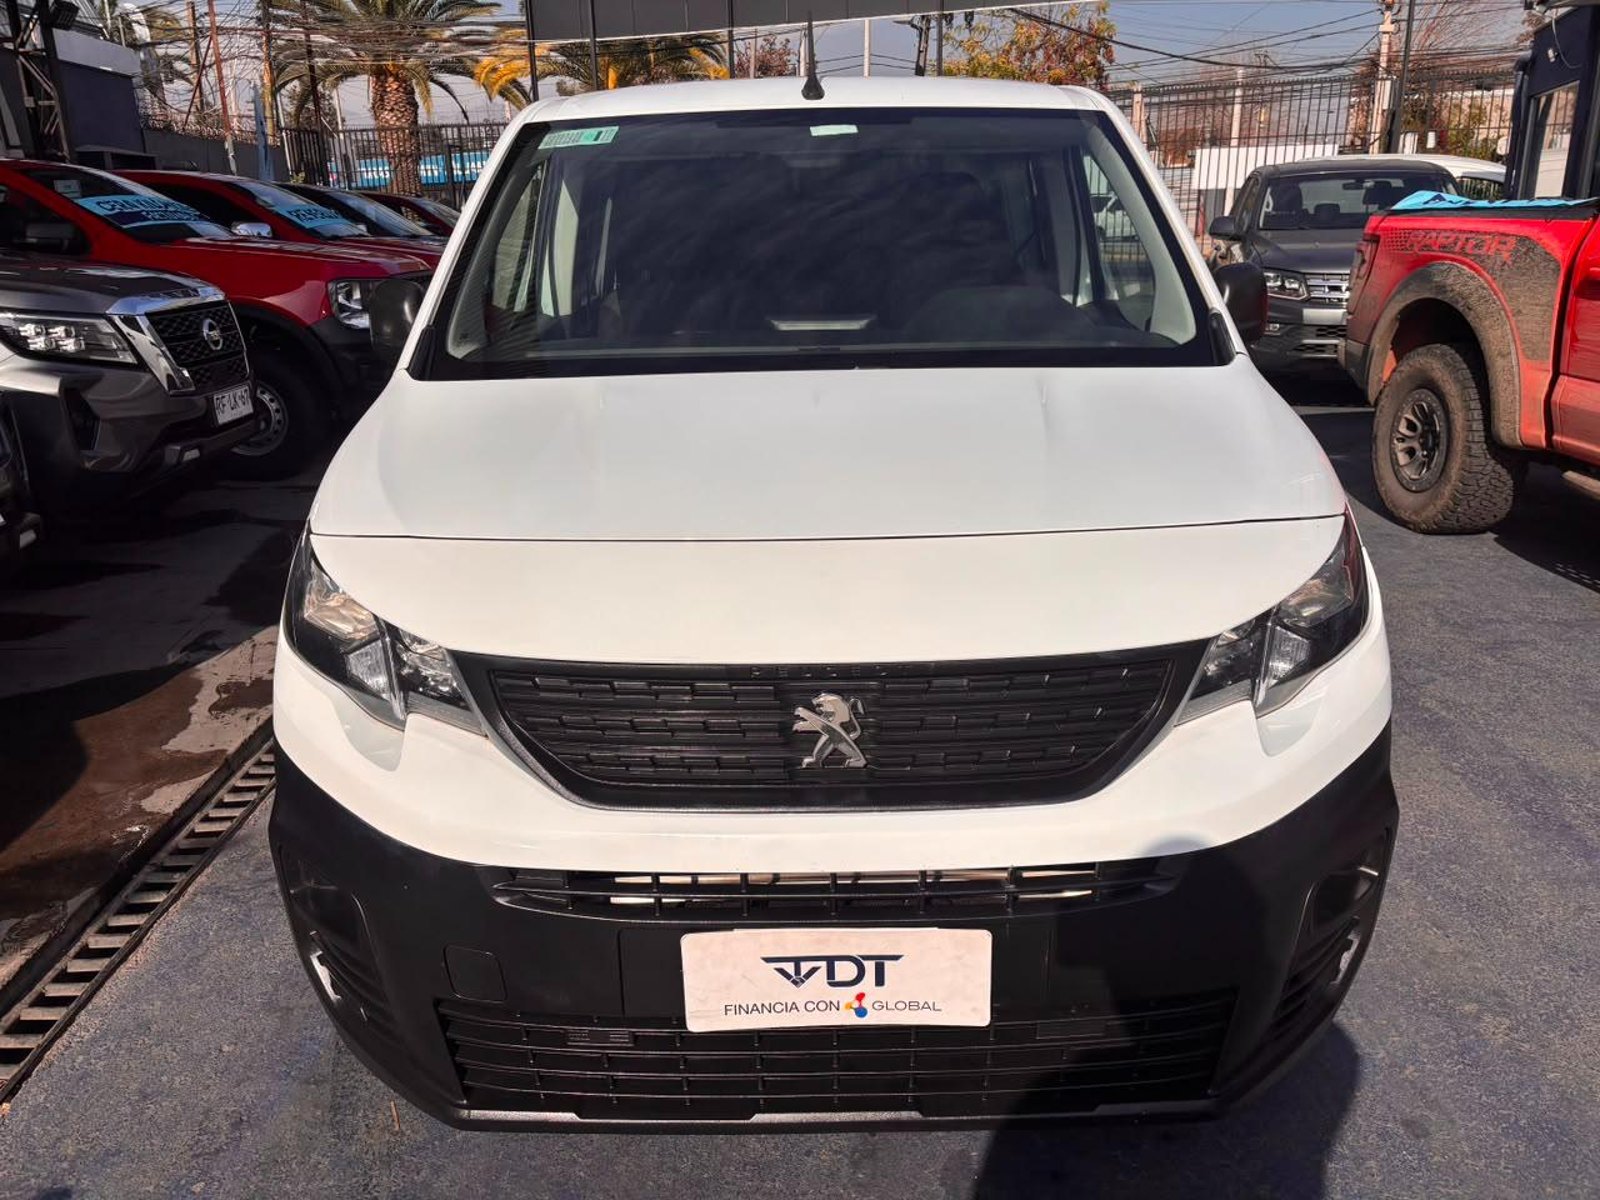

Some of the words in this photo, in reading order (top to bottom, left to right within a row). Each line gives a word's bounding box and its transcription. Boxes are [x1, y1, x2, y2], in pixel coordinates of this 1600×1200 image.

[724, 1001, 800, 1015] FINANCIA
[804, 1000, 840, 1012] CON
[871, 1001, 942, 1012] GLOBAL
